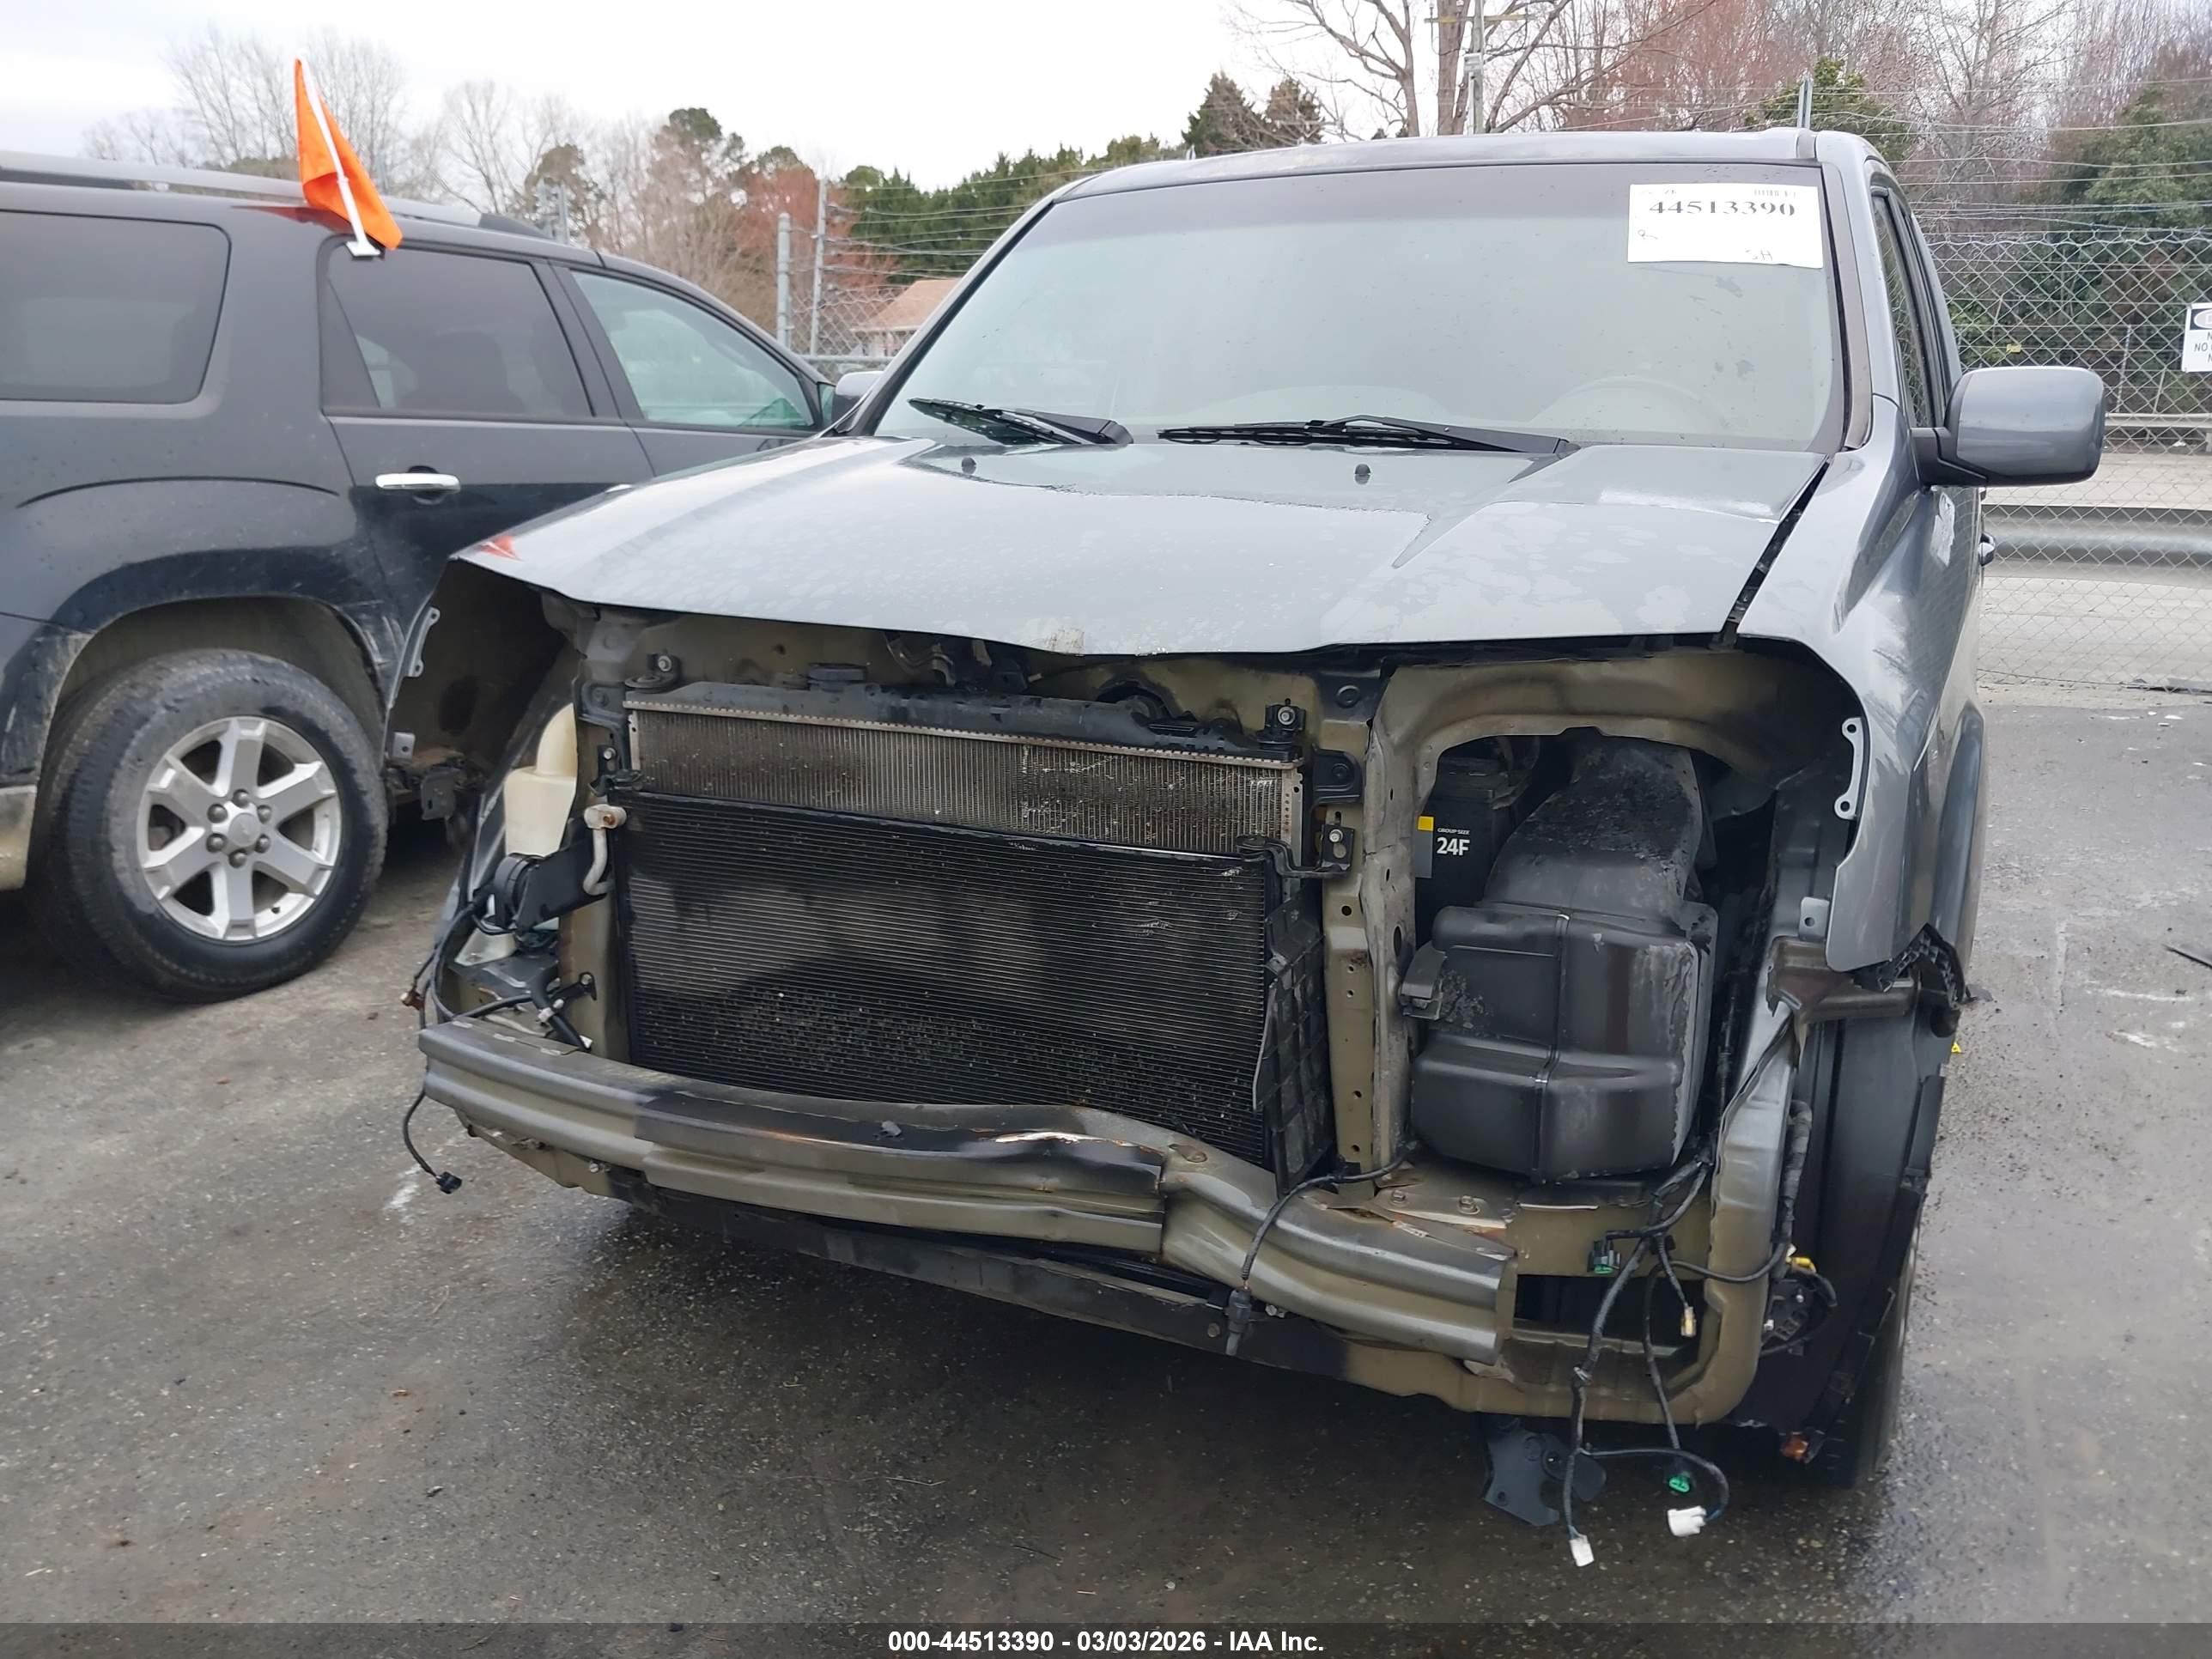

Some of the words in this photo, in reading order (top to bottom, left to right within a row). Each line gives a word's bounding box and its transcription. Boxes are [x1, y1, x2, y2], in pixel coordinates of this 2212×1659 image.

[1649, 201, 1796, 216] 44513390
[2193, 343, 2208, 352] NO
[1437, 836, 1470, 856] 24F
